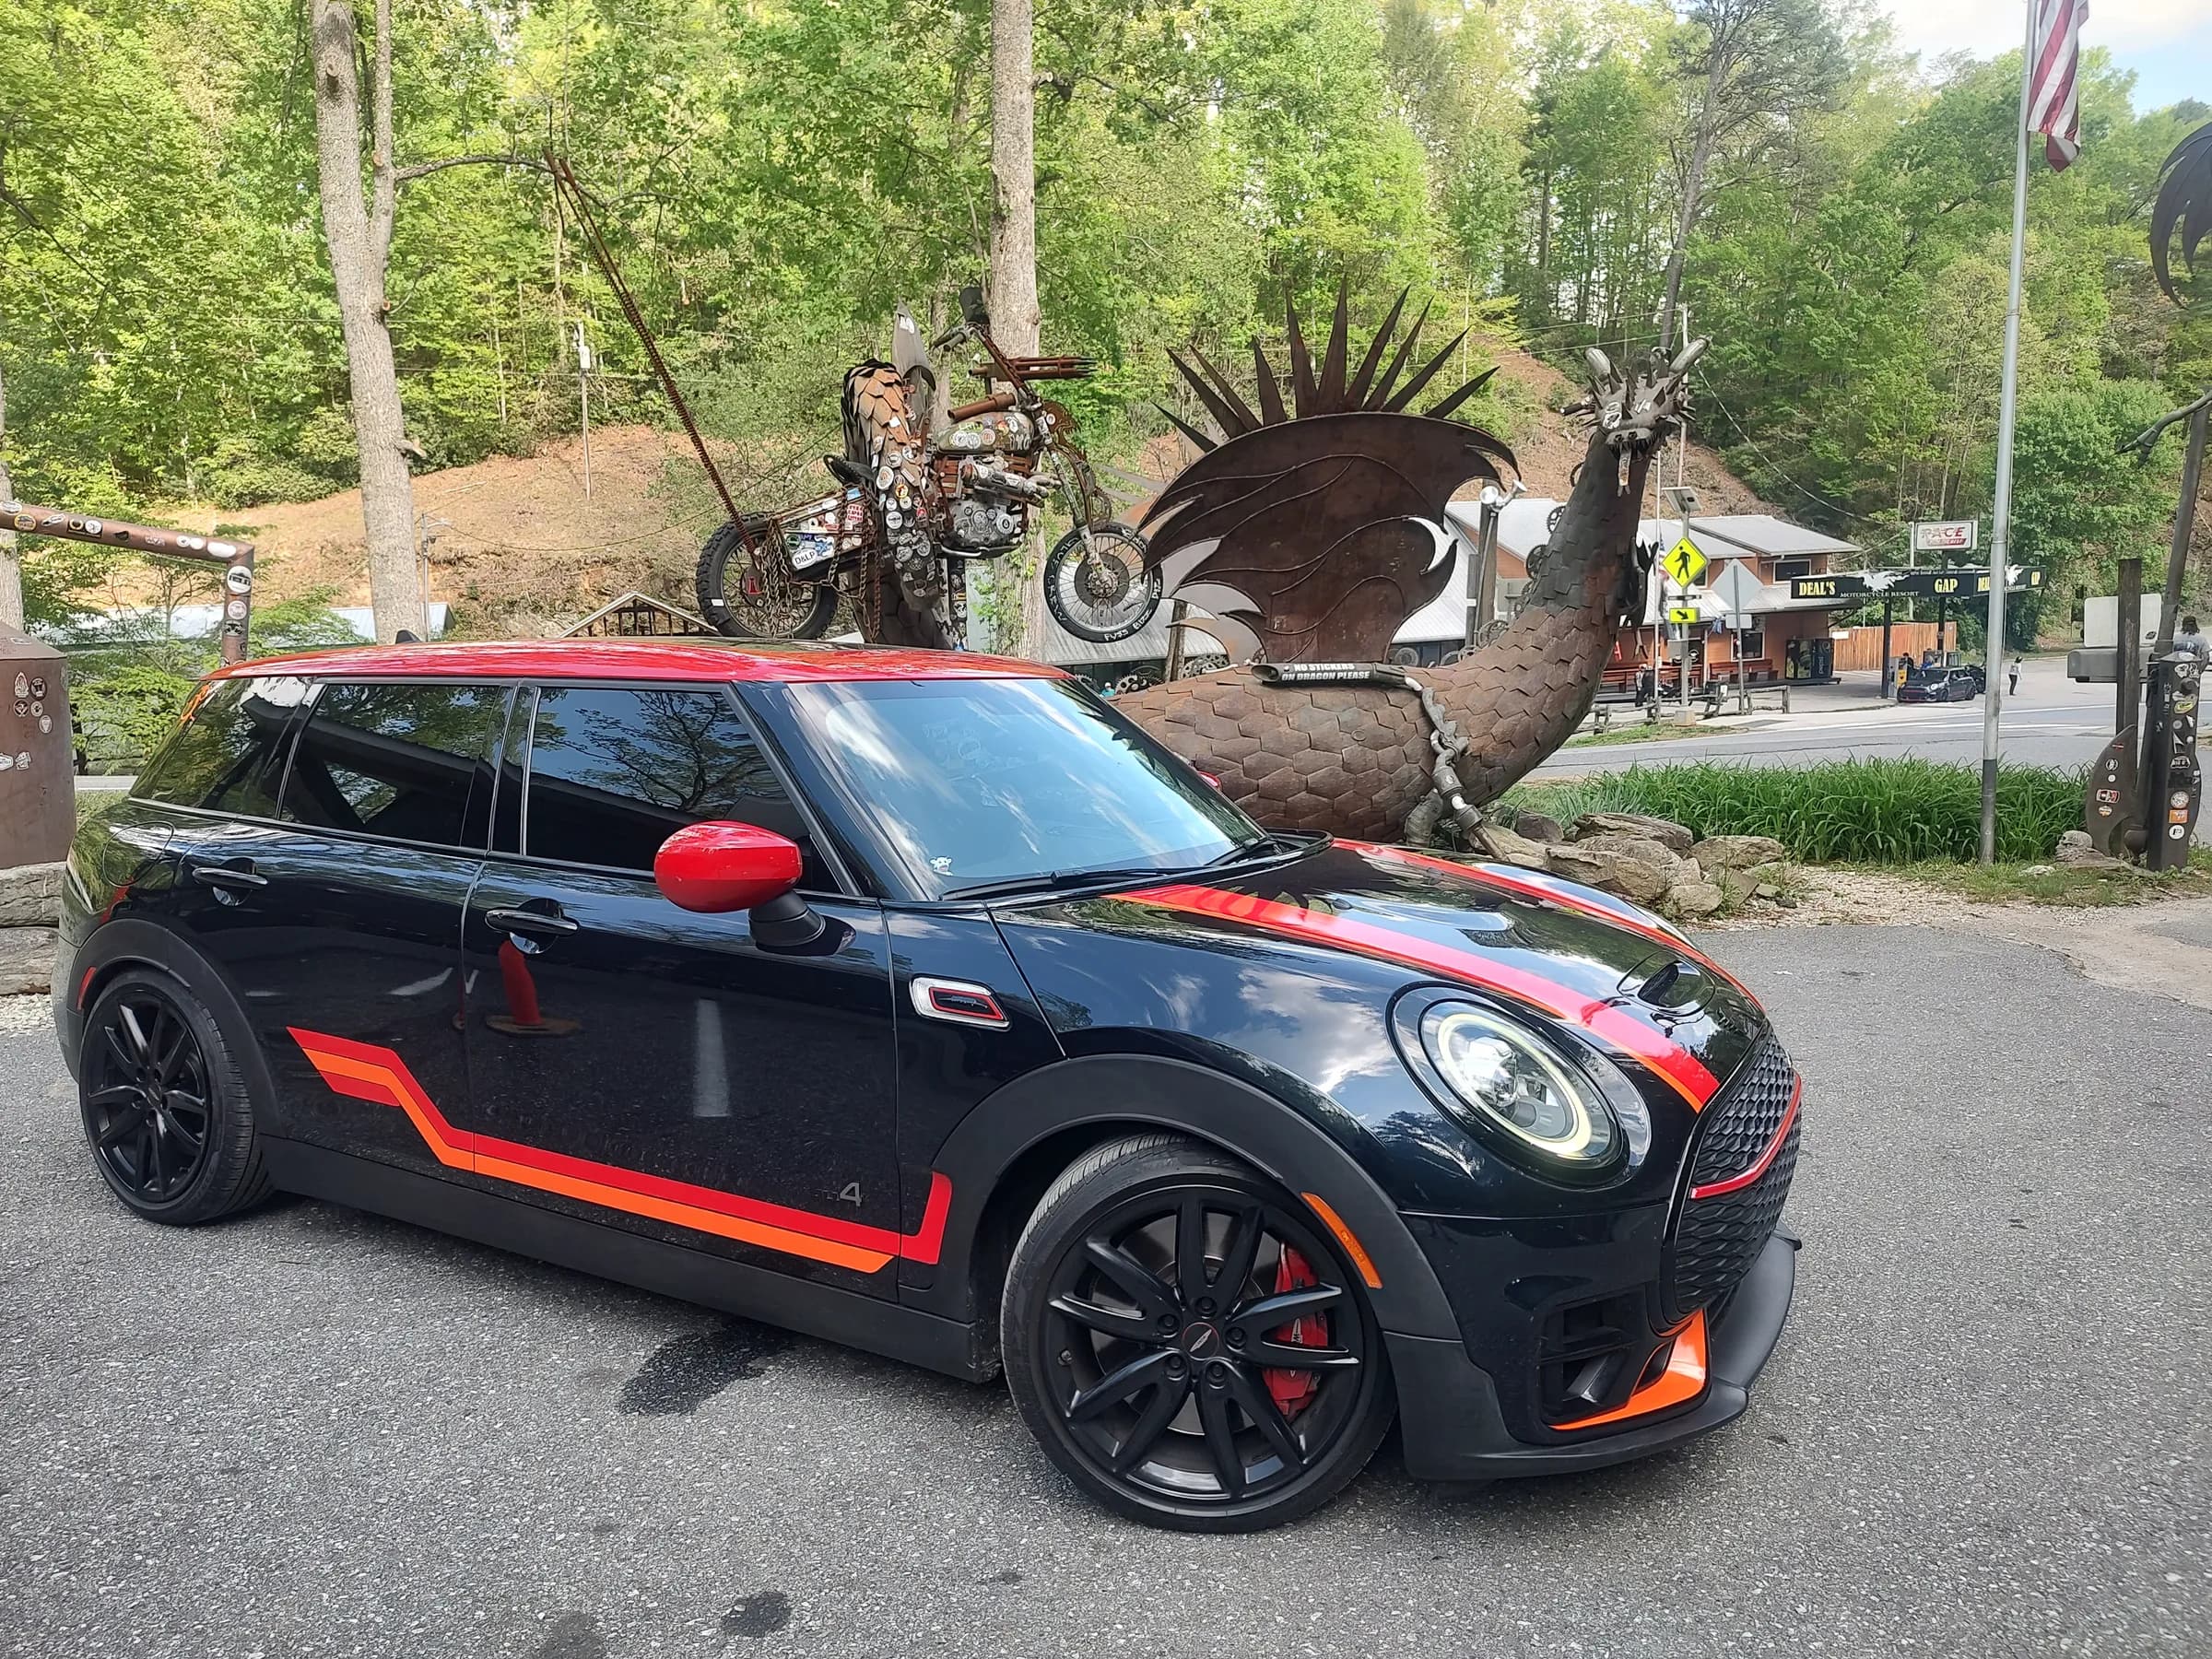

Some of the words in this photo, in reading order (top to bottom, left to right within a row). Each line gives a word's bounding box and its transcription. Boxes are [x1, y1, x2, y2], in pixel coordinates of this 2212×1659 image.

[1798, 581, 1836, 596] DEAL'S
[1934, 578, 1959, 594] GAP
[1293, 663, 1308, 672] NO
[1309, 663, 1356, 671] STICKERS
[1281, 672, 1295, 681] ON
[1297, 671, 1336, 680] DRAGON
[1336, 670, 1371, 680] PLEASE
